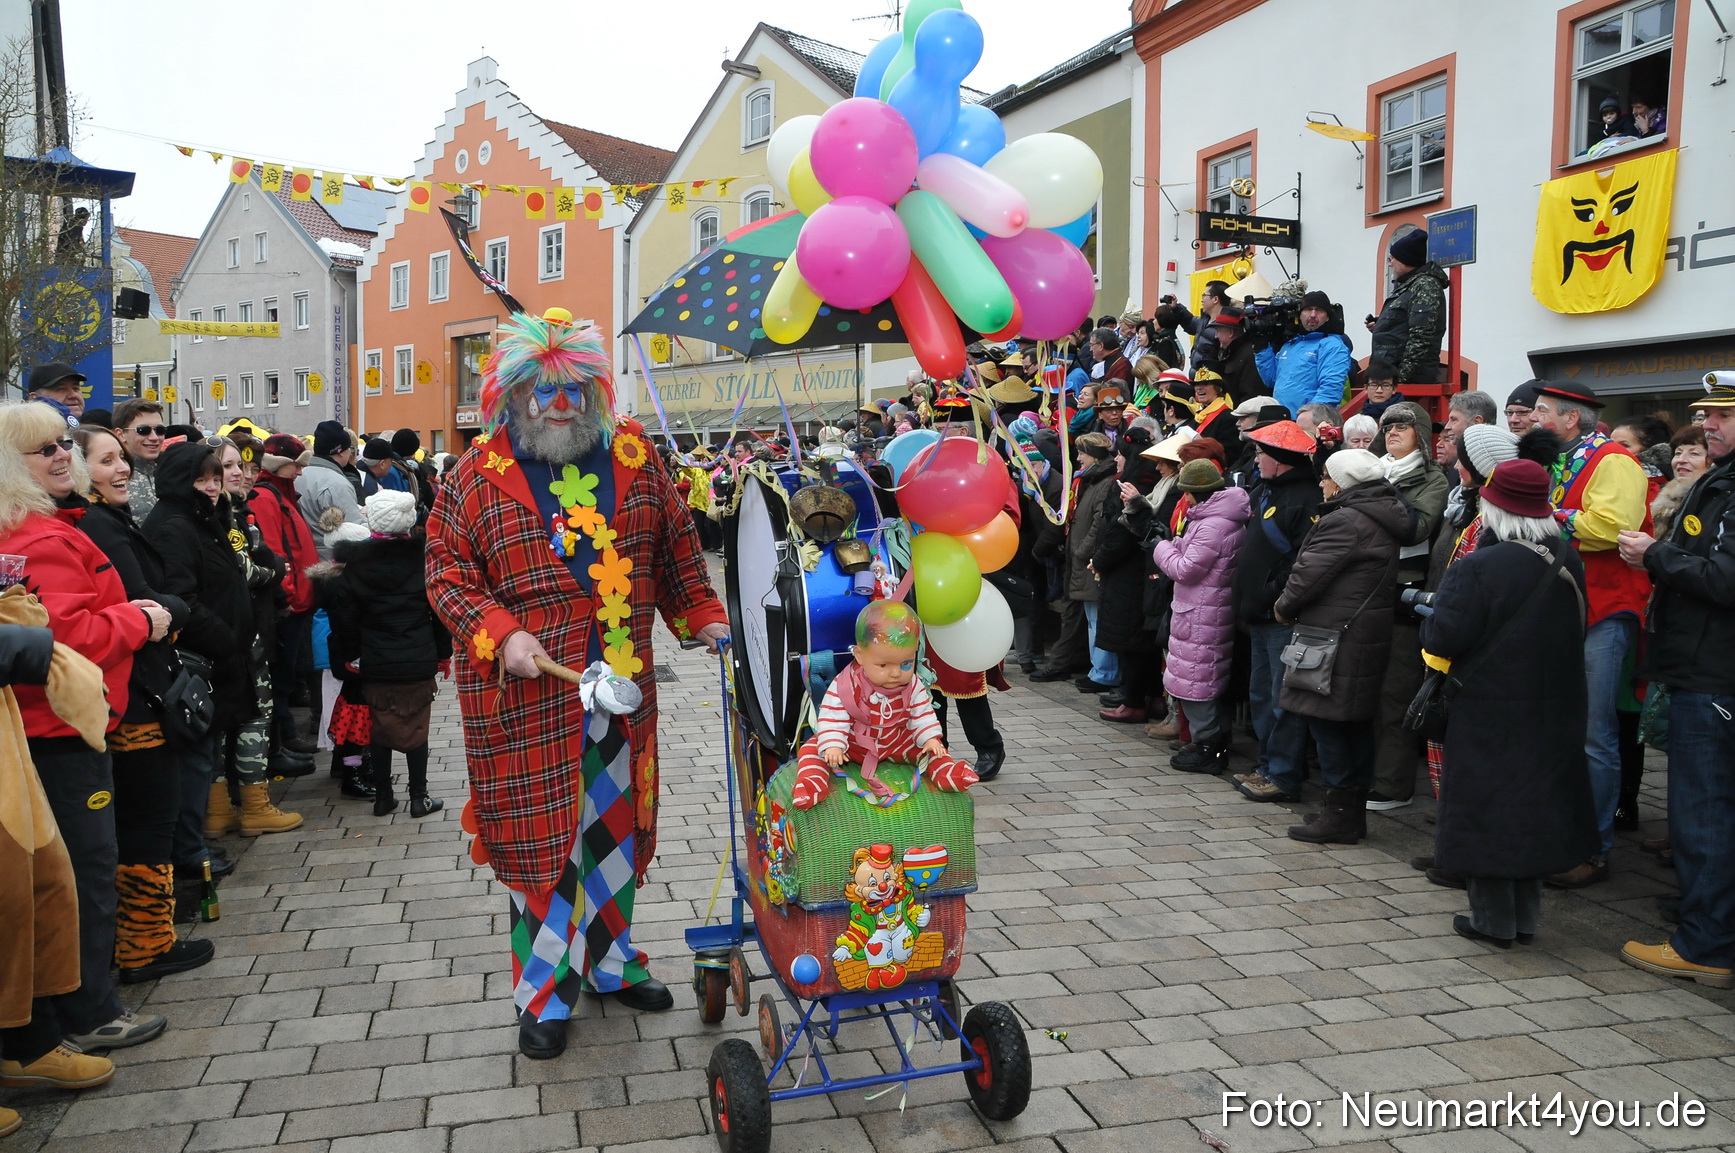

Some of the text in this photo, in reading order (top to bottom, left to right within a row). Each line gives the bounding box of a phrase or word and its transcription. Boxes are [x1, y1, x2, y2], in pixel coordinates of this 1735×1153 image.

[1210, 217, 1290, 236] RÖHLICH
[334, 358, 342, 421] SCHMUCK
[644, 368, 865, 403] BCKEREI STOLL KONDITO
